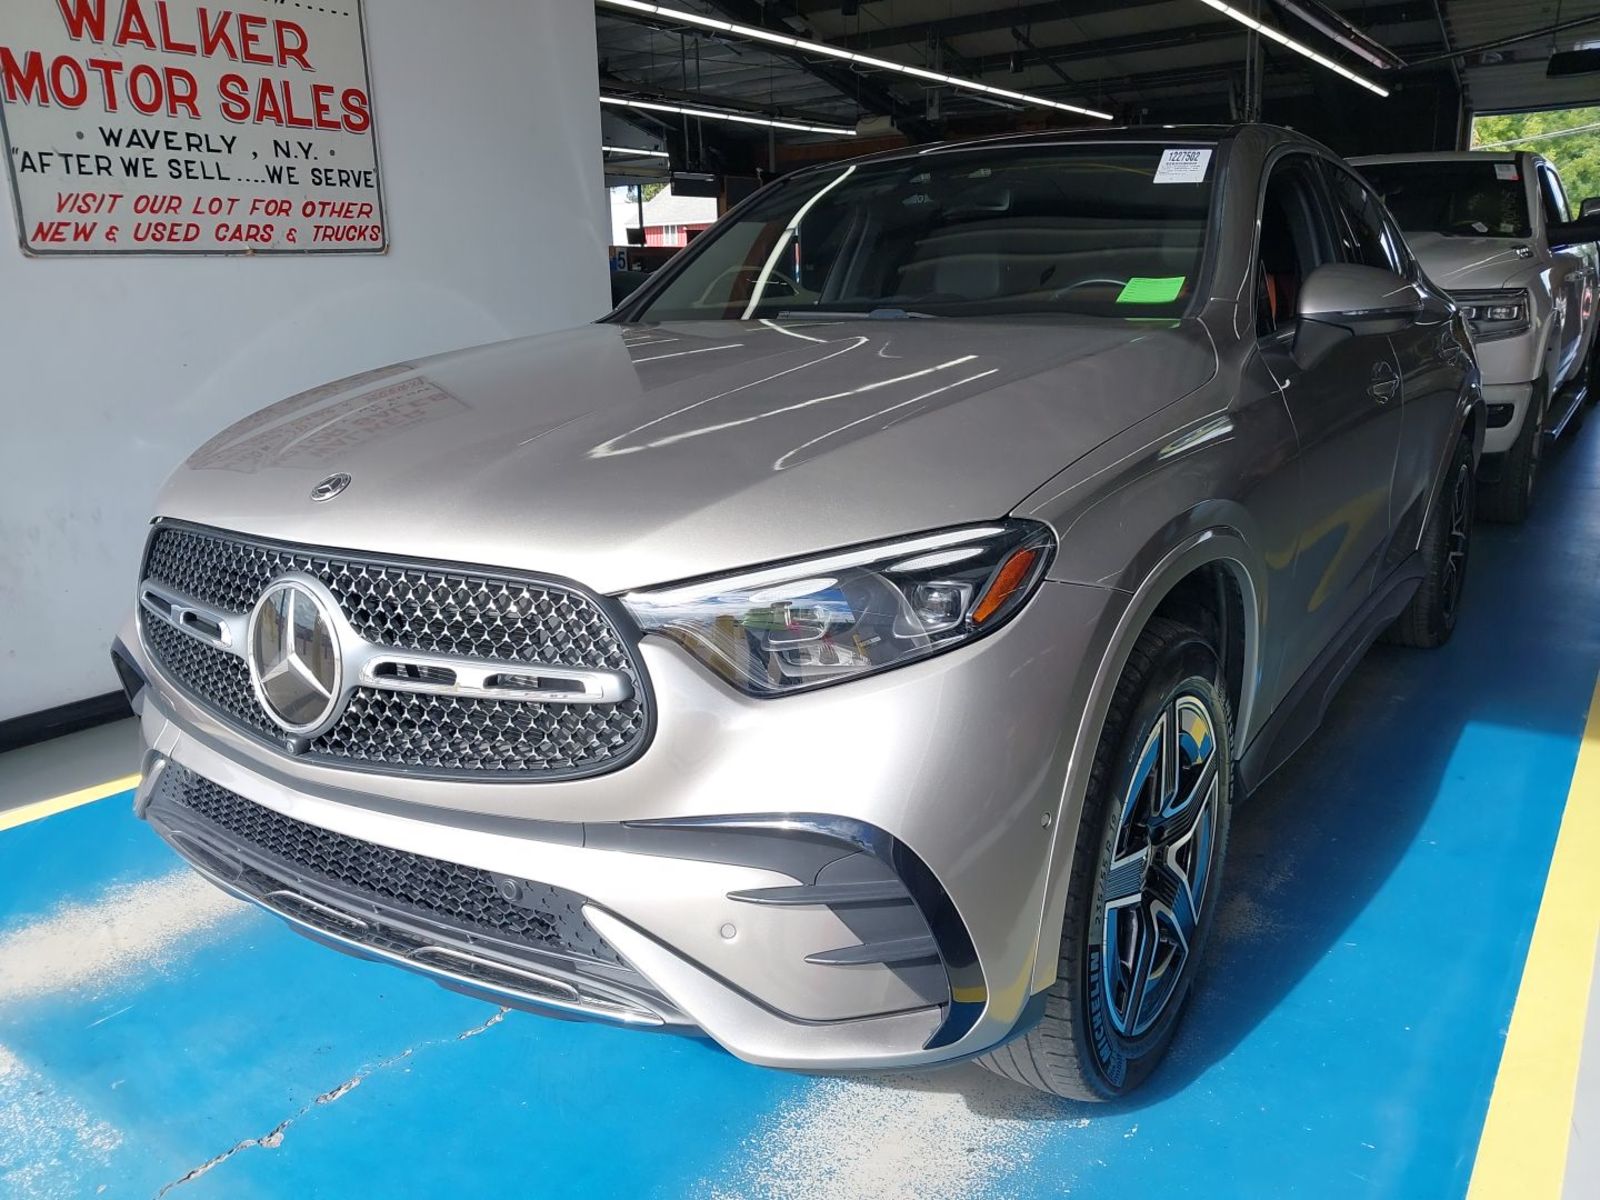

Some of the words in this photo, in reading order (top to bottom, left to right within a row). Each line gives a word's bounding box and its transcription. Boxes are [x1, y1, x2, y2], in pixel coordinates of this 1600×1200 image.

[56, 0, 315, 72] WALKER
[0, 46, 201, 119] MOTOR
[217, 73, 370, 134] SALES
[273, 139, 319, 160] N.Y.
[1168, 151, 1200, 161] 1227502
[120, 156, 158, 178] WE
[265, 164, 299, 185] WE
[56, 192, 124, 214] VISIT
[133, 194, 183, 214] OUR
[192, 196, 241, 215] LOT
[250, 198, 293, 217] FOR
[302, 200, 374, 219] OTHER
[31, 221, 98, 242] NEW
[105, 225, 119, 243] &
[133, 222, 200, 242] USED
[214, 222, 274, 243] CARS
[286, 228, 297, 244] &
[312, 224, 381, 242] TRUCKS
[1090, 950, 1112, 1065] MICHELIN
